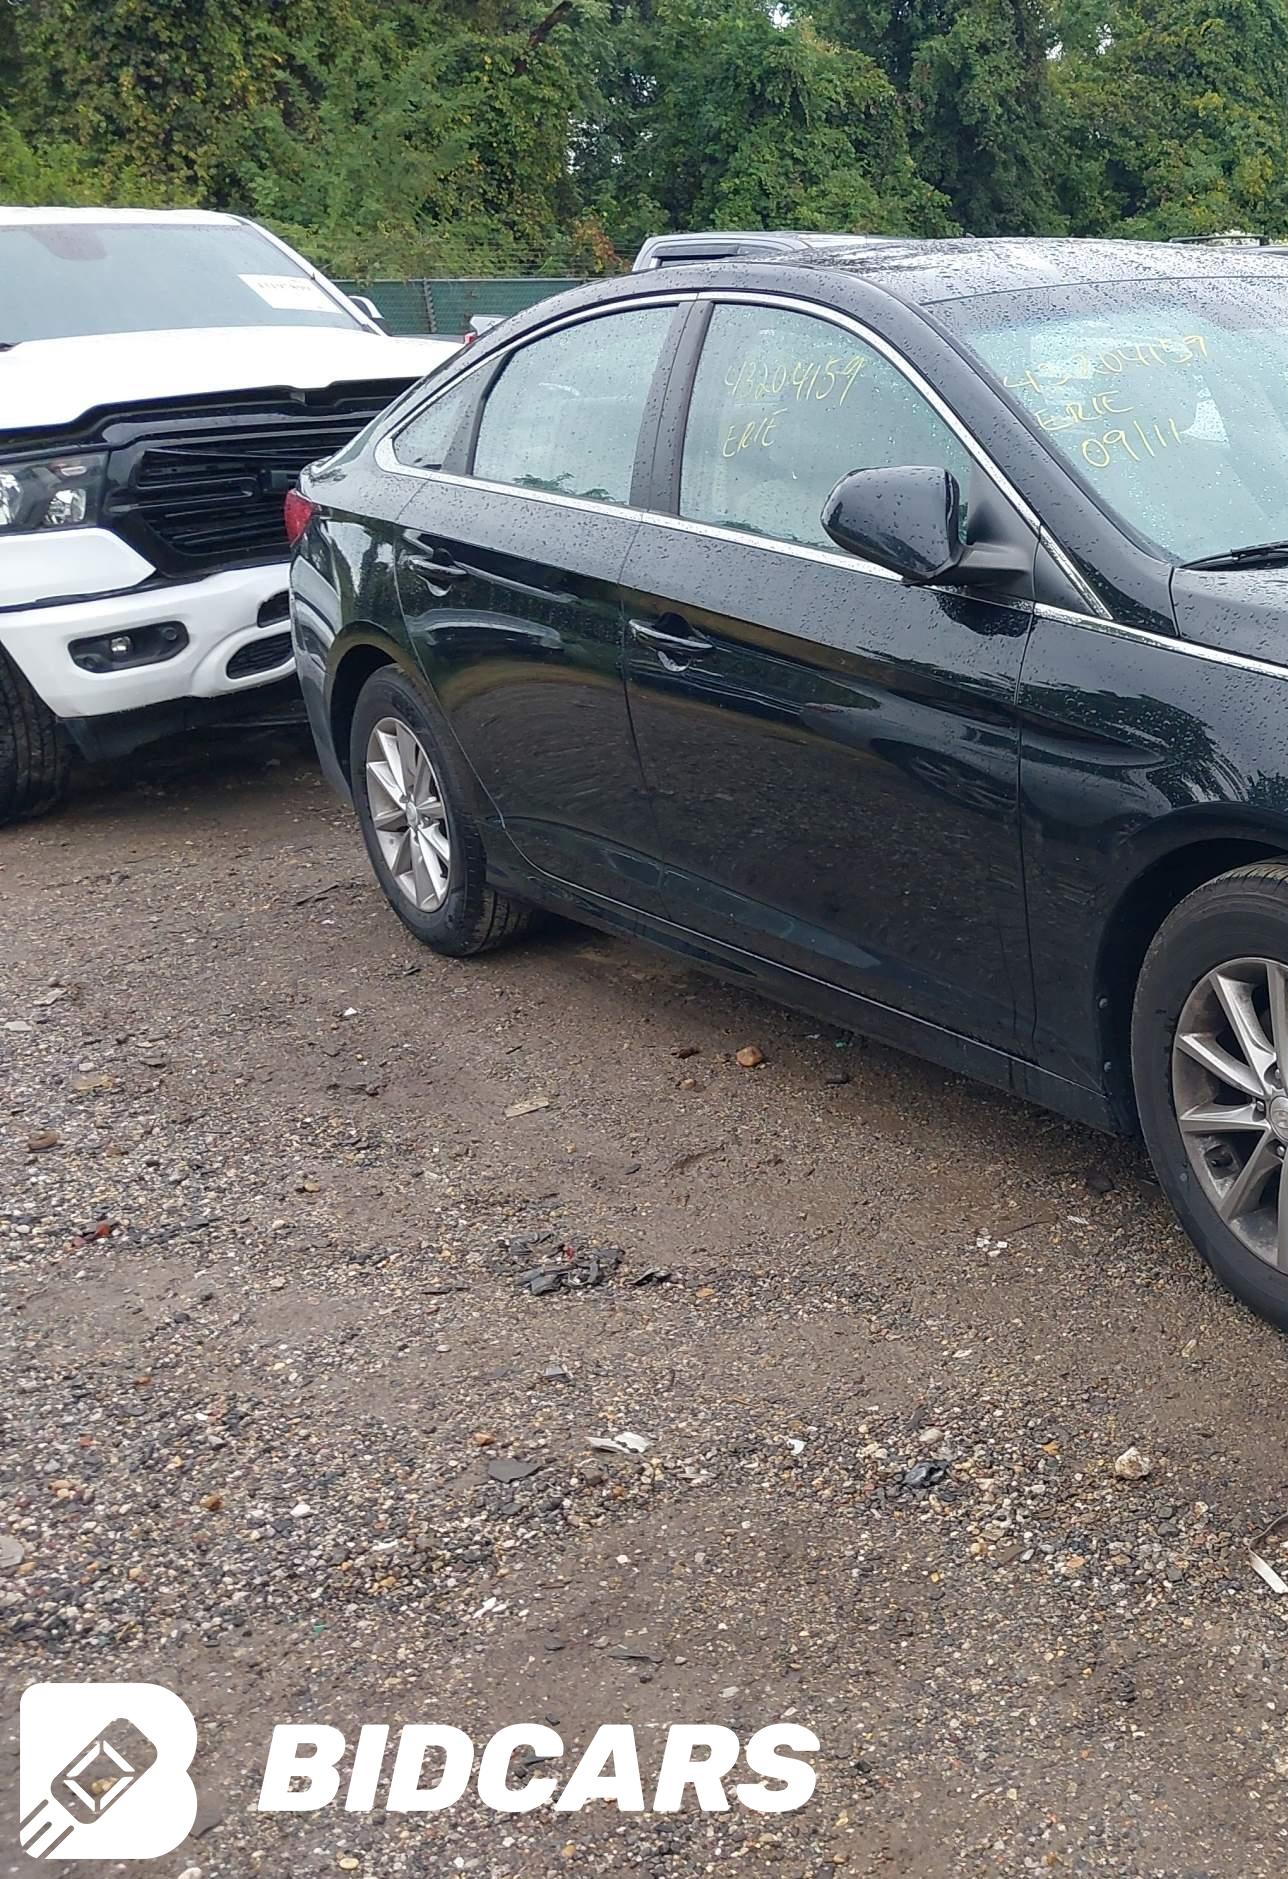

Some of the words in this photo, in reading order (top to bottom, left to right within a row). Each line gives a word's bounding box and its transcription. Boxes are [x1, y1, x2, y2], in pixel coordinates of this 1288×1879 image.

[724, 356, 865, 407] 43204159
[723, 408, 788, 457] ERIE
[1034, 391, 1134, 431] ERIE
[1082, 418, 1181, 467] 09/11
